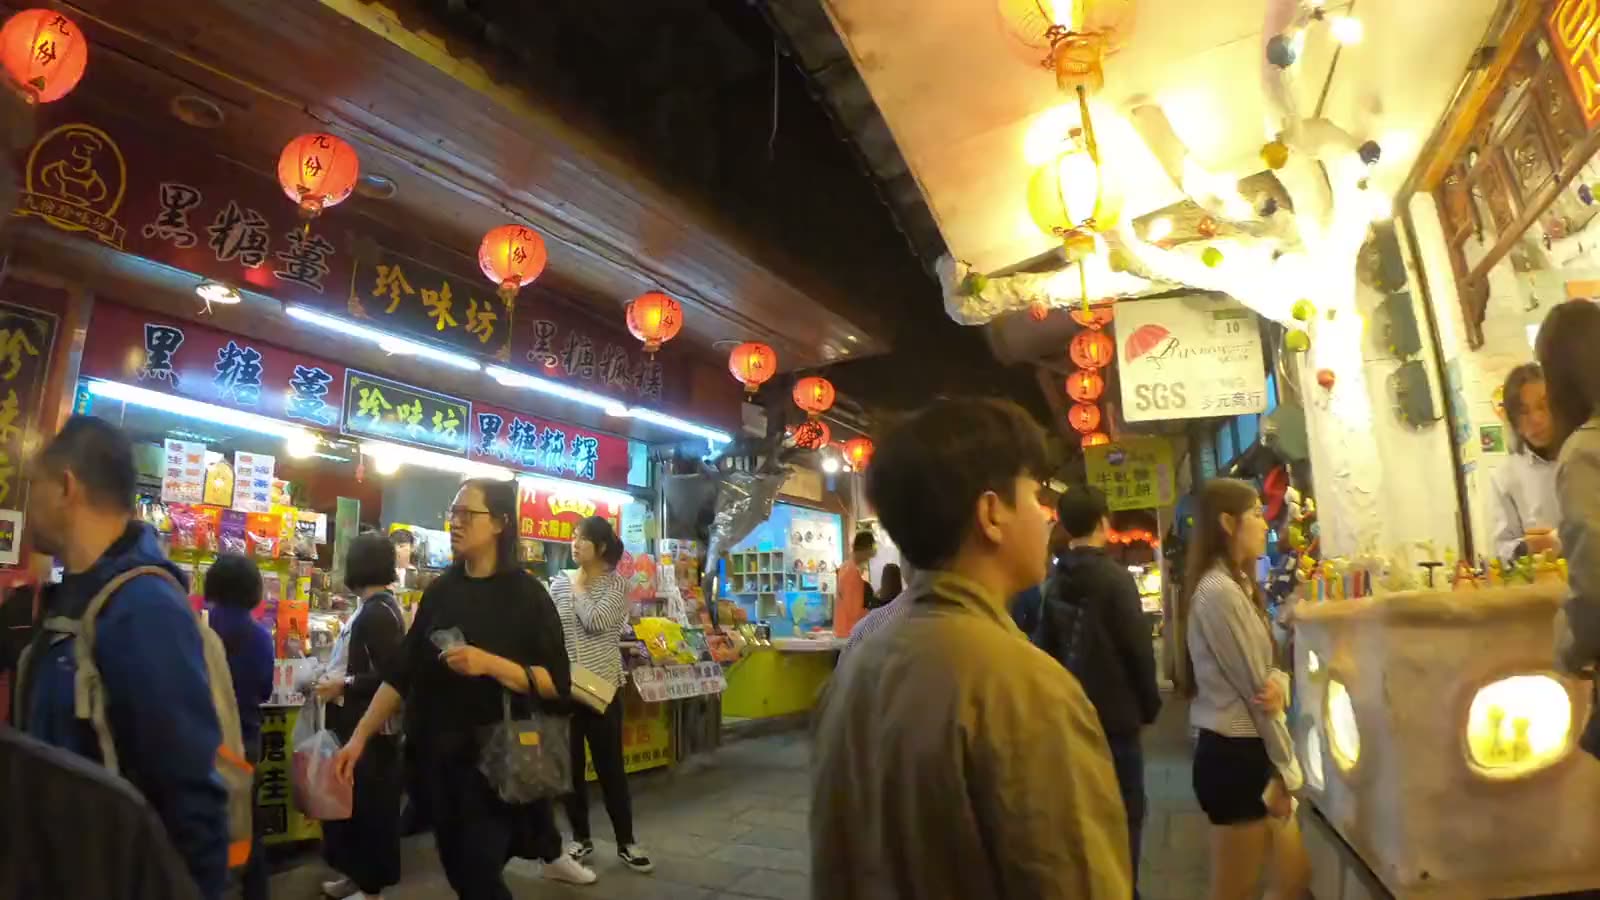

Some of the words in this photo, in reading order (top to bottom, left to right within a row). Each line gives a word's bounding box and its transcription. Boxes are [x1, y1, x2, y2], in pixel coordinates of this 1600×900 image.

[36, 16, 70, 66] 九份
[304, 136, 330, 176] 九份
[512, 229, 531, 264] 九份
[372, 264, 497, 343] 珍味坊
[1226, 321, 1240, 334] 10
[356, 387, 460, 444] 珍味坊
[1135, 383, 1186, 411] SGS
